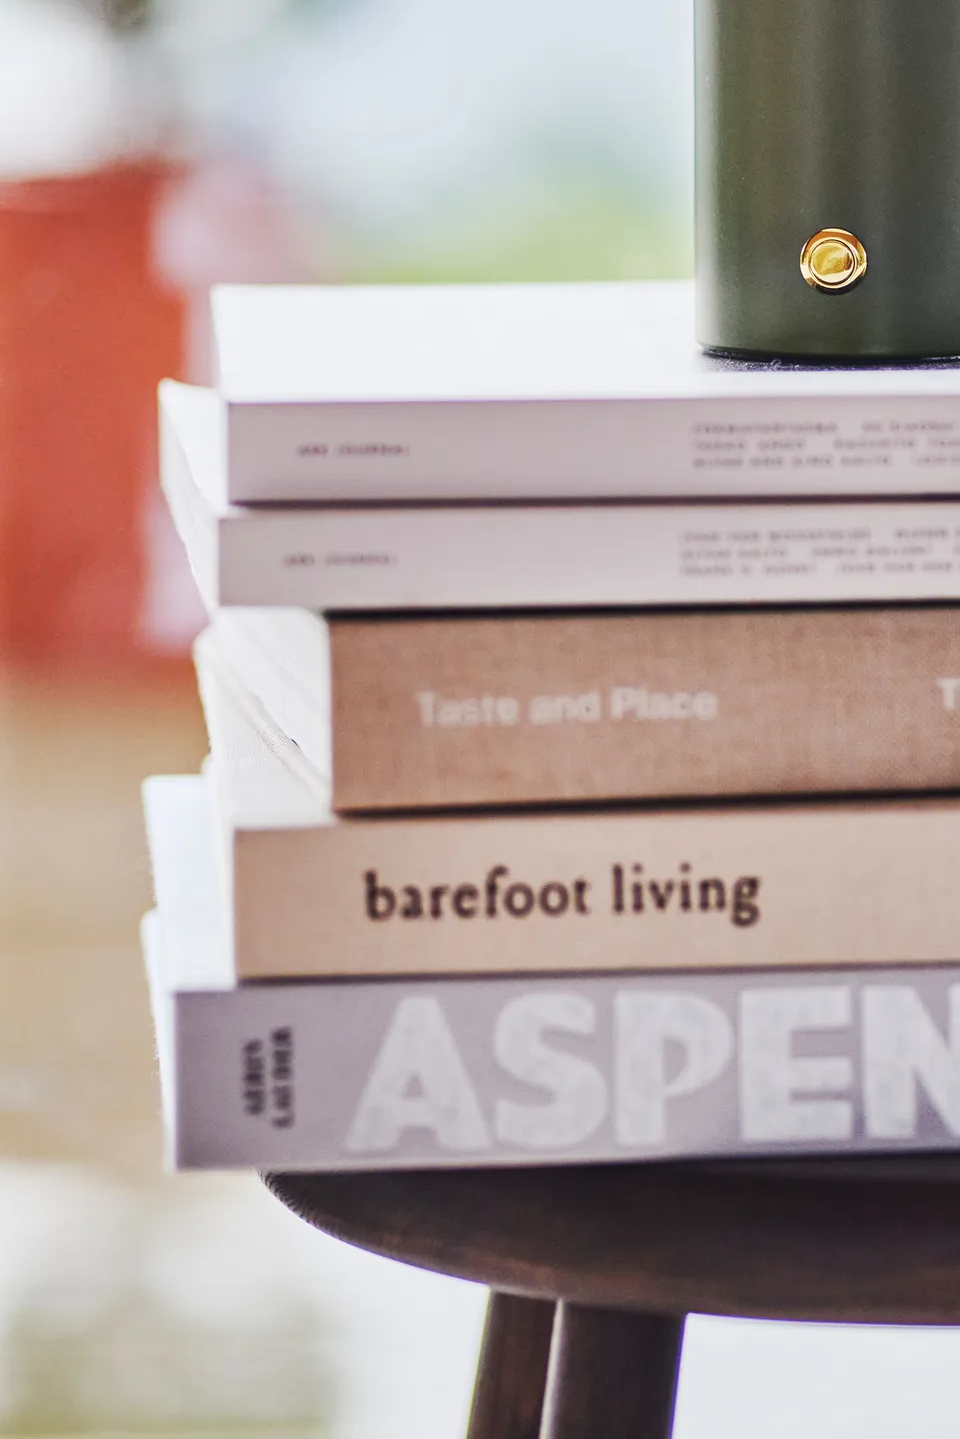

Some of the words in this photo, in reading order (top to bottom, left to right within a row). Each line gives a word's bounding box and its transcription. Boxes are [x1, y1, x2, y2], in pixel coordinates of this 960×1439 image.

[416, 691, 519, 727] Taste
[529, 691, 600, 725] and
[610, 686, 718, 721] Place
[363, 863, 590, 921] barefoot
[611, 862, 762, 928] living
